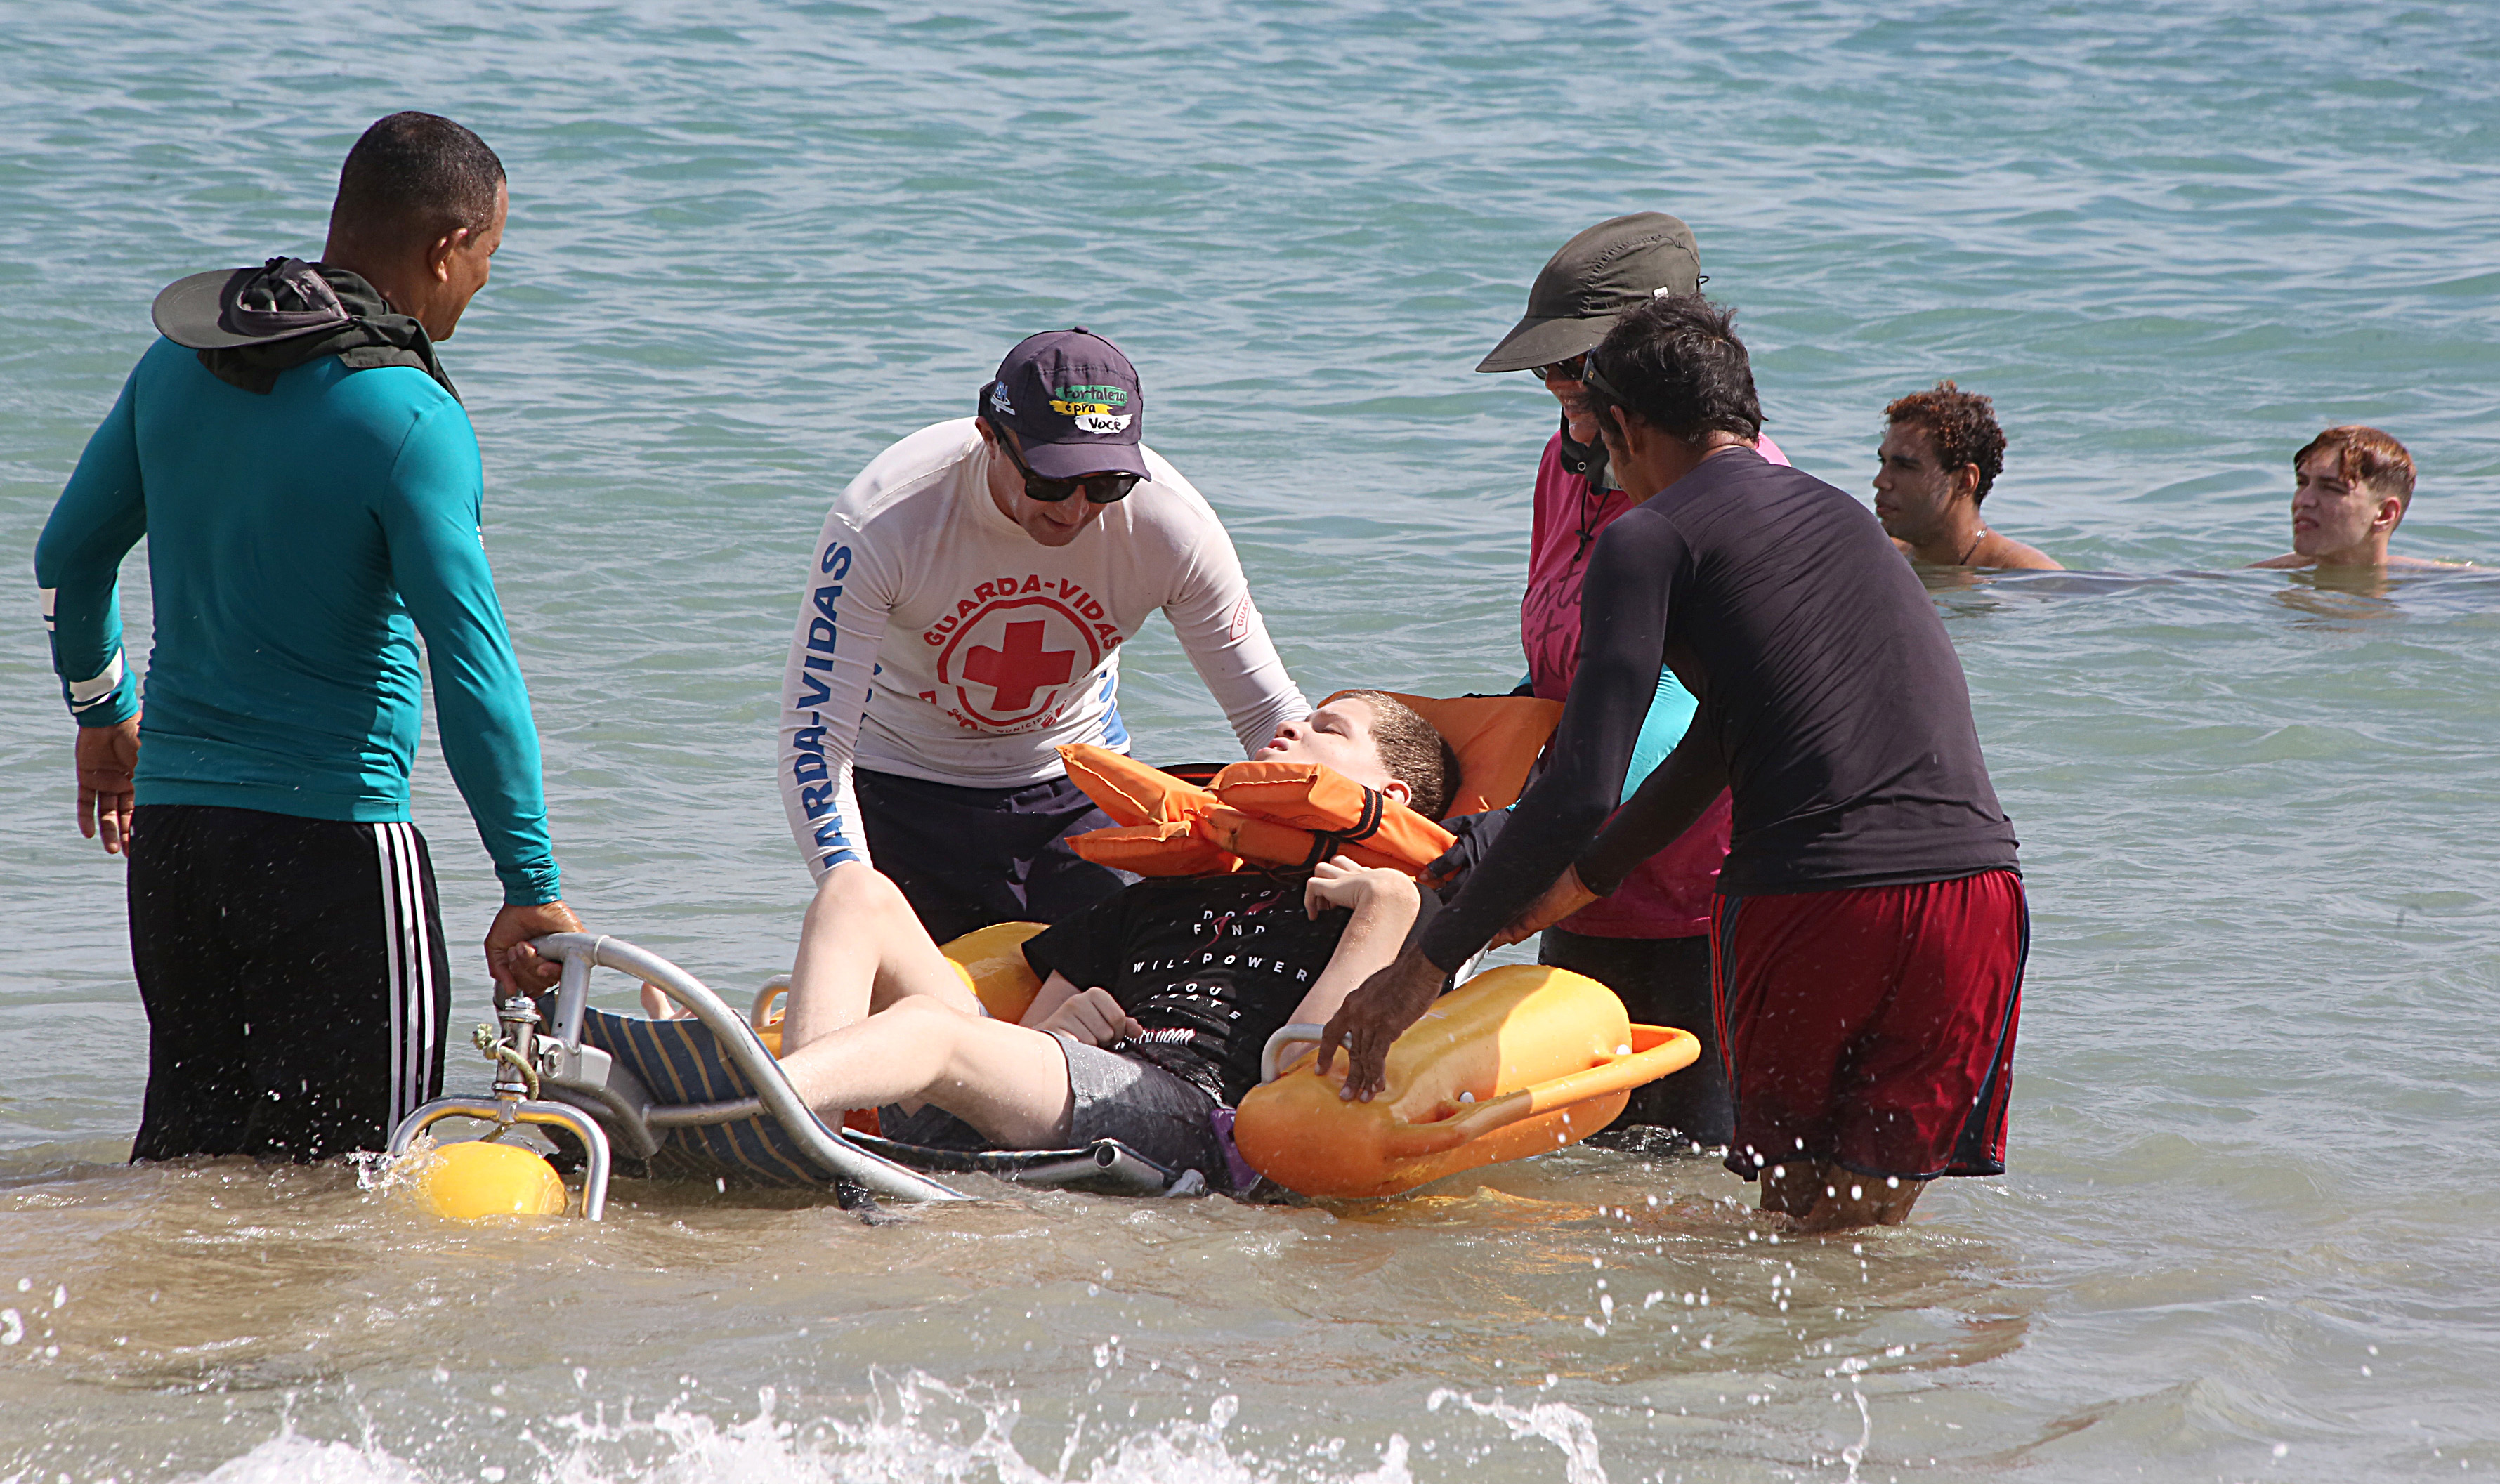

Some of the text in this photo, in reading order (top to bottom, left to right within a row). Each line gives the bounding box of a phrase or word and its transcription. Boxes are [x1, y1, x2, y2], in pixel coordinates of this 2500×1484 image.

[1088, 417, 1122, 431] Você
[923, 574, 1123, 651] GUARDA-VIDAS
[793, 541, 861, 869] ARDA-VIDAS
[1194, 924, 1265, 936] FIND
